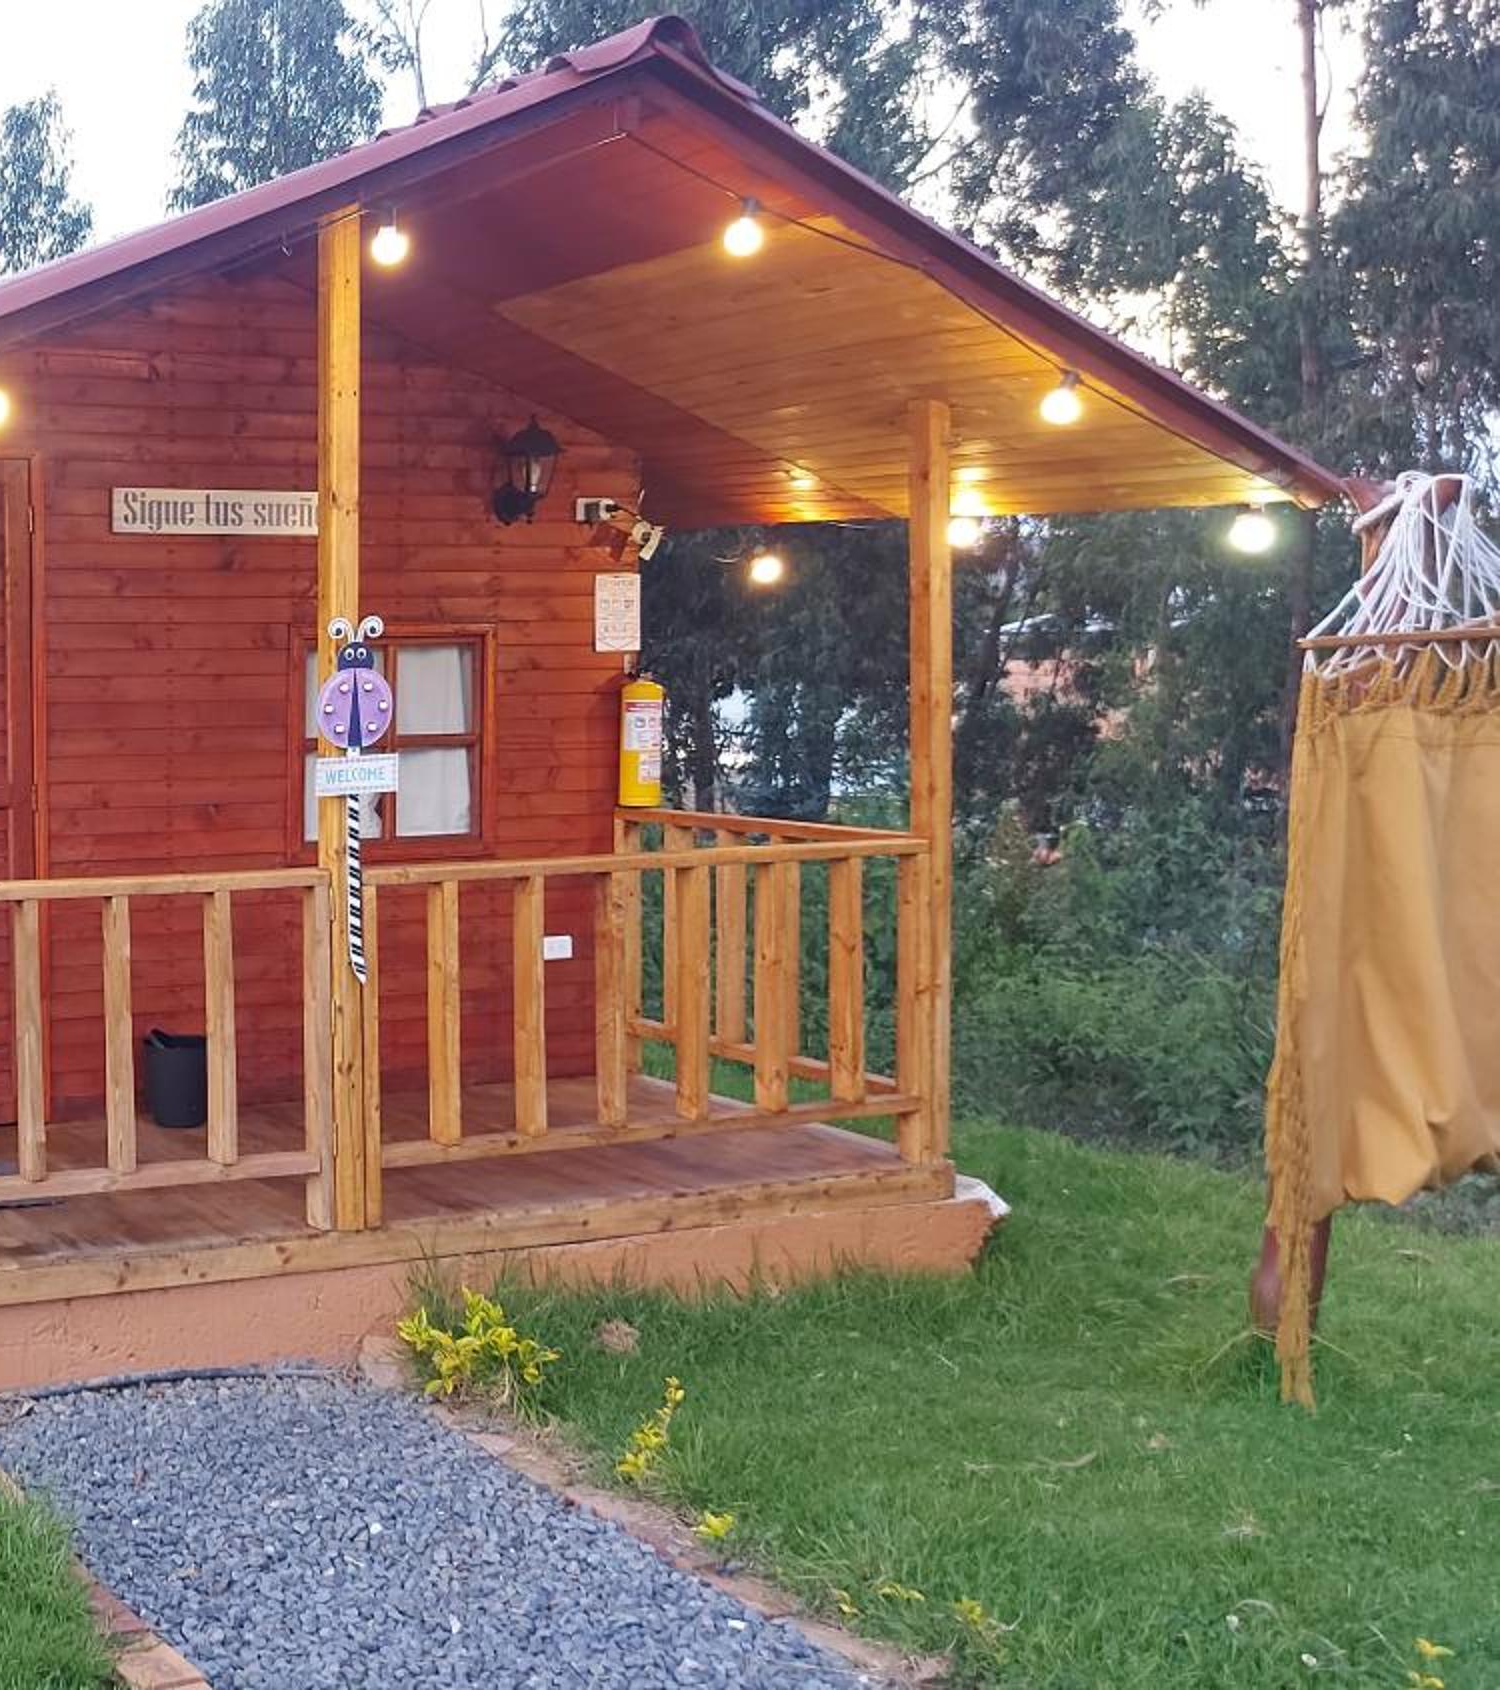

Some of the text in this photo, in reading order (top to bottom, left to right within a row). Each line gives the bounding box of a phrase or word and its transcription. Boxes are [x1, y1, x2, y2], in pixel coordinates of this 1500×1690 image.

[122, 490, 318, 531] Sigue tus sueñ
[325, 767, 387, 785] WELCOME
